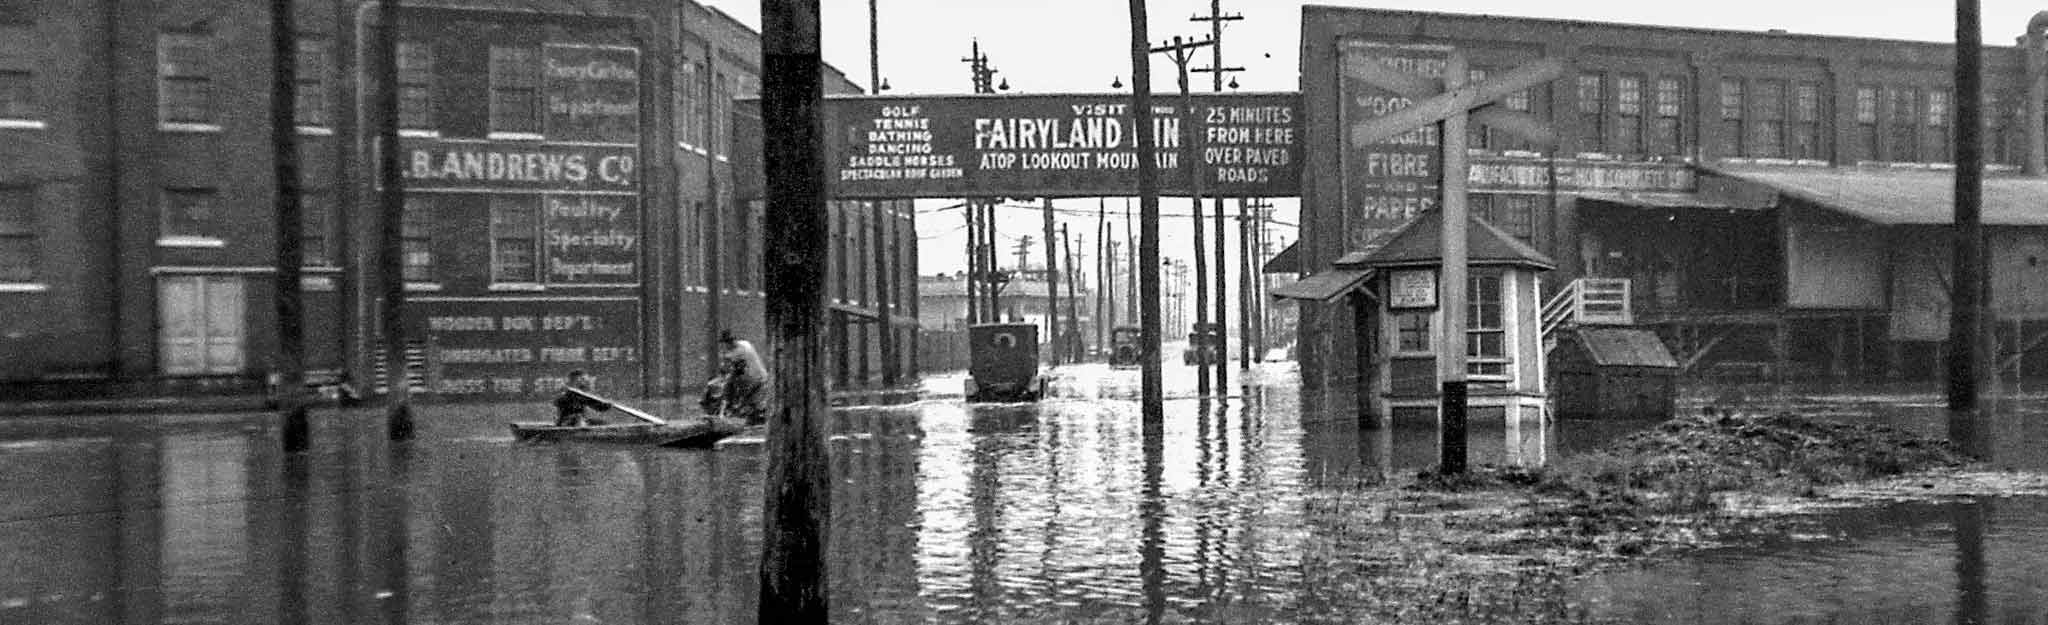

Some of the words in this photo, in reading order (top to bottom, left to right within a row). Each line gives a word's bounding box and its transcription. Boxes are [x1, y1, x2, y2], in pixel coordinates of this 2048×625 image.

[881, 106, 920, 118] GOLF
[1072, 103, 1128, 116] VISIT
[1206, 106, 1226, 124] 25
[1230, 106, 1292, 124] MINUTES
[873, 118, 929, 130] TENNIS
[868, 131, 933, 142] BATHING
[975, 118, 1122, 149] FAIRYLAND
[1207, 127, 1250, 144] FROM
[1255, 127, 1293, 145] HERE
[868, 143, 932, 155] DANCING
[1205, 147, 1242, 165] OVER
[1246, 148, 1289, 166] PAVED
[849, 155, 901, 168] SADDLE
[904, 155, 955, 167] HORSES
[979, 152, 1016, 170] ATOP
[1022, 152, 1090, 170] LOOKOUT
[1368, 153, 1429, 176] FIBRE
[841, 168, 901, 181] SPECTACULAR
[929, 168, 964, 180] GARDEN
[1217, 167, 1269, 183] ROADS
[551, 199, 621, 222] Poultry
[550, 230, 635, 251] Specialty
[551, 256, 635, 281] Department
[503, 316, 535, 332] BOX
